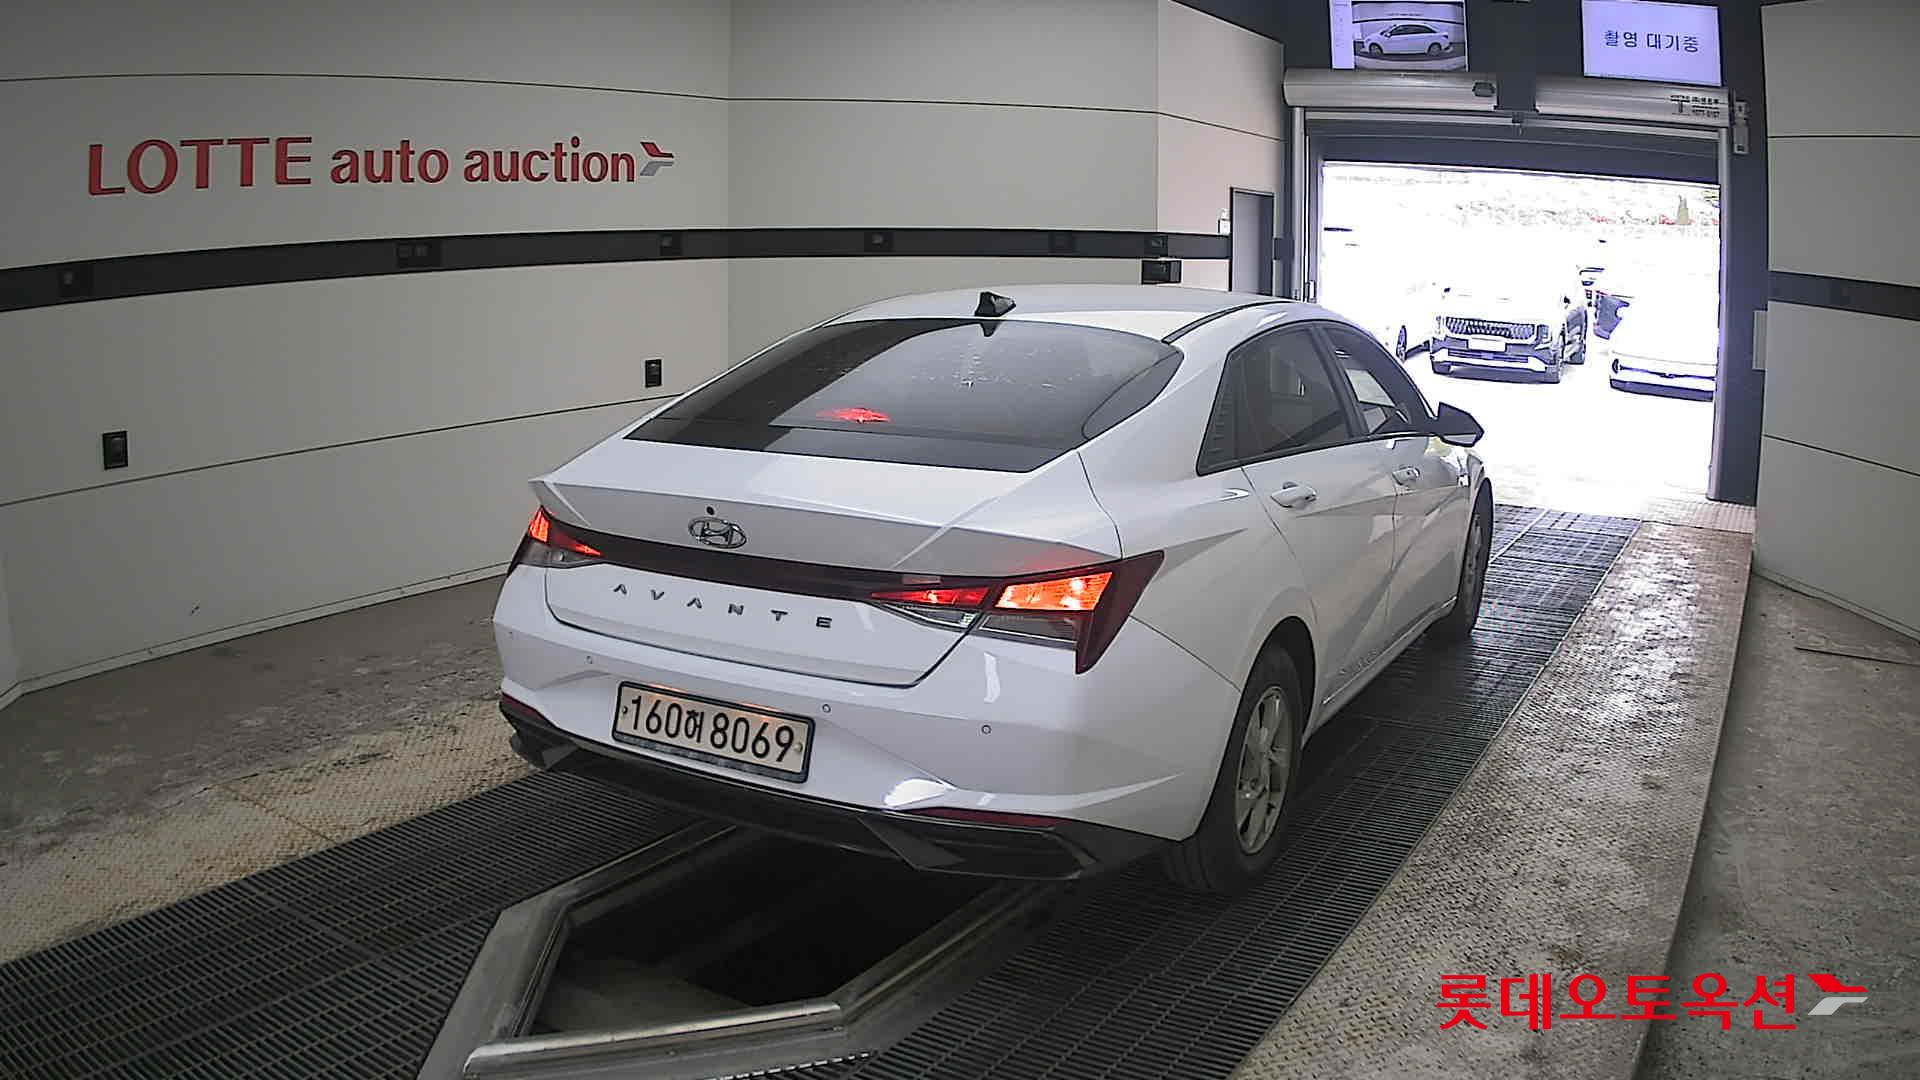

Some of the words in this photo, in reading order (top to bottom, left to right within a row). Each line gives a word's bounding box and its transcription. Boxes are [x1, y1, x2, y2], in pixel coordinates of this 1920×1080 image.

[1604, 30, 1638, 48] 촬영
[88, 136, 313, 196] LOTTE
[330, 139, 449, 184] auto
[463, 136, 636, 183] auction
[613, 583, 833, 629] AVANTE
